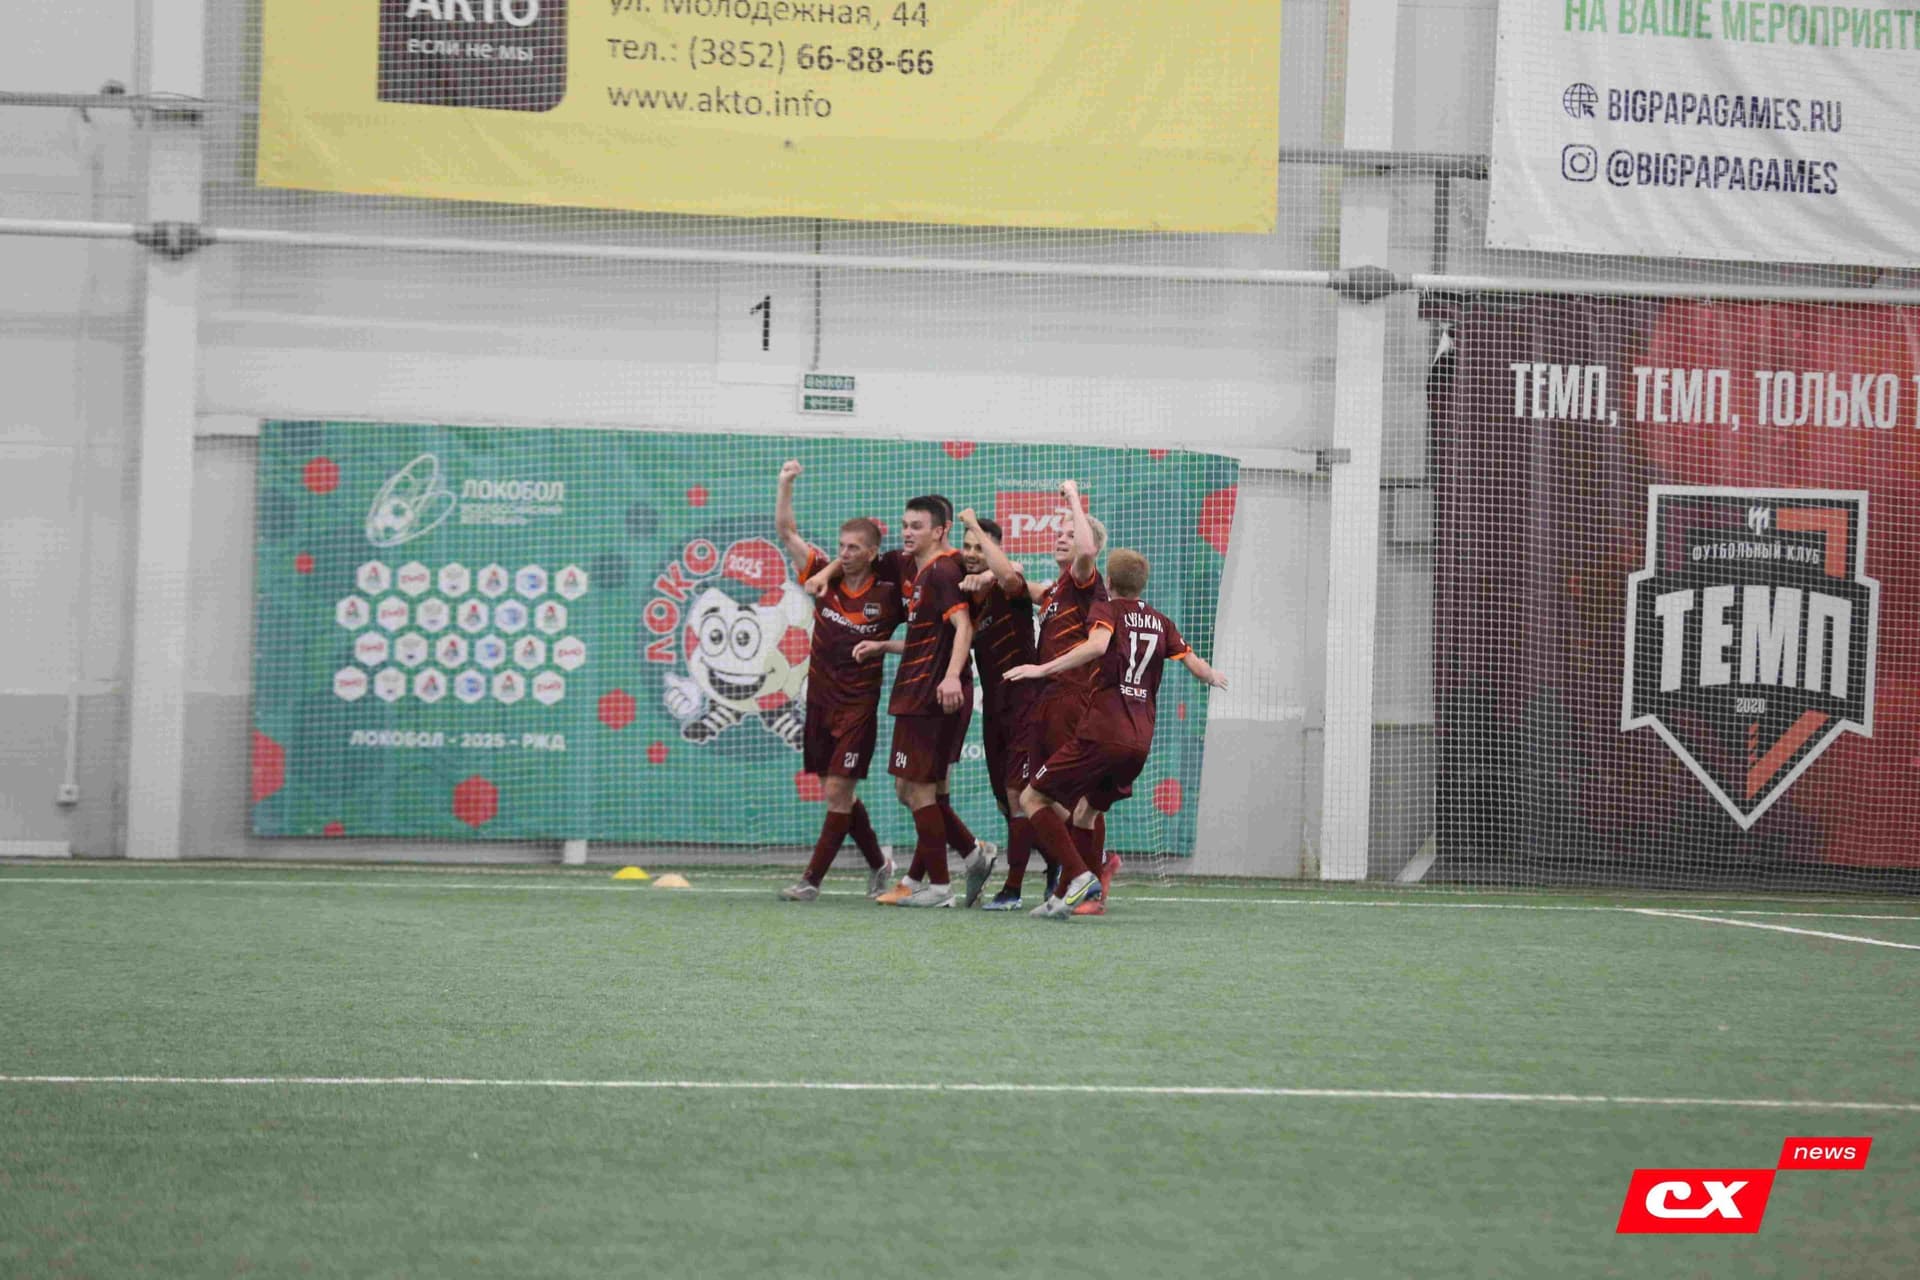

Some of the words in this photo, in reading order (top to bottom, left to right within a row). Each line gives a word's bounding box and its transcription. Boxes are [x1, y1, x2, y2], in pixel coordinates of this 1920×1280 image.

[892, 2, 929, 28] 44
[1565, 0, 1607, 32] НА
[1618, 0, 1713, 39] ВАШЕ
[1721, 0, 1920, 50] МЕРОПРИЯТ
[407, 38, 460, 56] если
[465, 42, 494, 59] не
[500, 45, 534, 61] мы
[607, 38, 678, 61] тел.:
[690, 36, 785, 75] (3852)
[797, 44, 934, 75] 66-88-66
[608, 86, 832, 117] www.akto.info
[1607, 88, 1843, 133] BIGPAPAGAMES.RU
[1606, 149, 1840, 195] @BIGPAPAGAMES
[750, 295, 771, 351] 1
[1510, 363, 1618, 427] ТЕМП,
[1633, 367, 1741, 431] ТЕМП,
[1754, 371, 1899, 429] ТОЛЬКО
[463, 479, 564, 501] ЛОКОБОЛ
[728, 554, 765, 579] 2025
[1692, 540, 1781, 561] ФУТБОЛЬНЫЙ
[1787, 545, 1820, 565] КЛУБ
[1125, 631, 1158, 684] 17
[1655, 584, 1851, 700] ТЕМП
[1736, 698, 1766, 713] 2020
[351, 730, 445, 748] ЛОКОБОЛ
[460, 732, 506, 748] 2025
[522, 733, 567, 750] РЖД
[895, 751, 907, 768] 24
